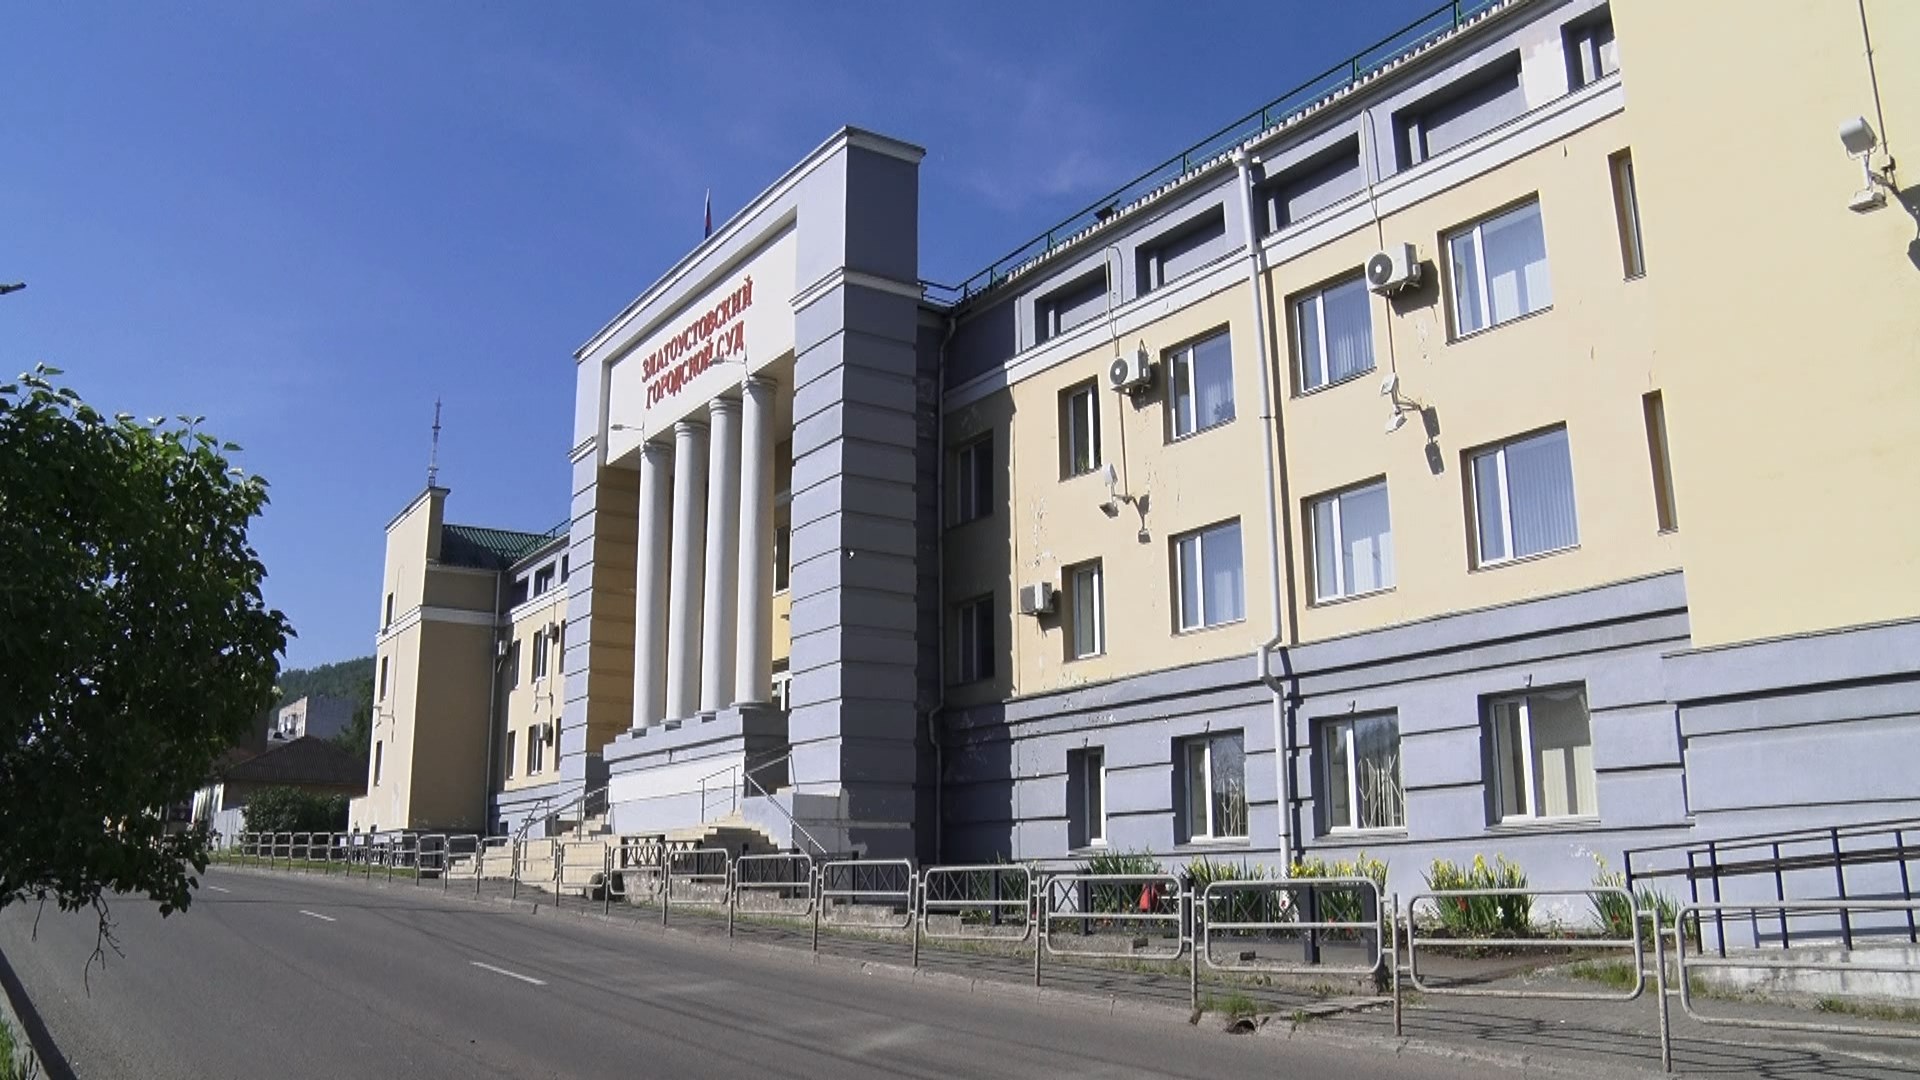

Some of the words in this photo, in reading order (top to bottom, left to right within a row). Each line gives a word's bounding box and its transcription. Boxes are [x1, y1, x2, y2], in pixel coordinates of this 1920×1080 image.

[642, 274, 753, 383] ЗЛАТОУСТОВСКИЙ
[646, 338, 714, 409] ГОРОДСКОЙ
[717, 320, 744, 358] СУД
